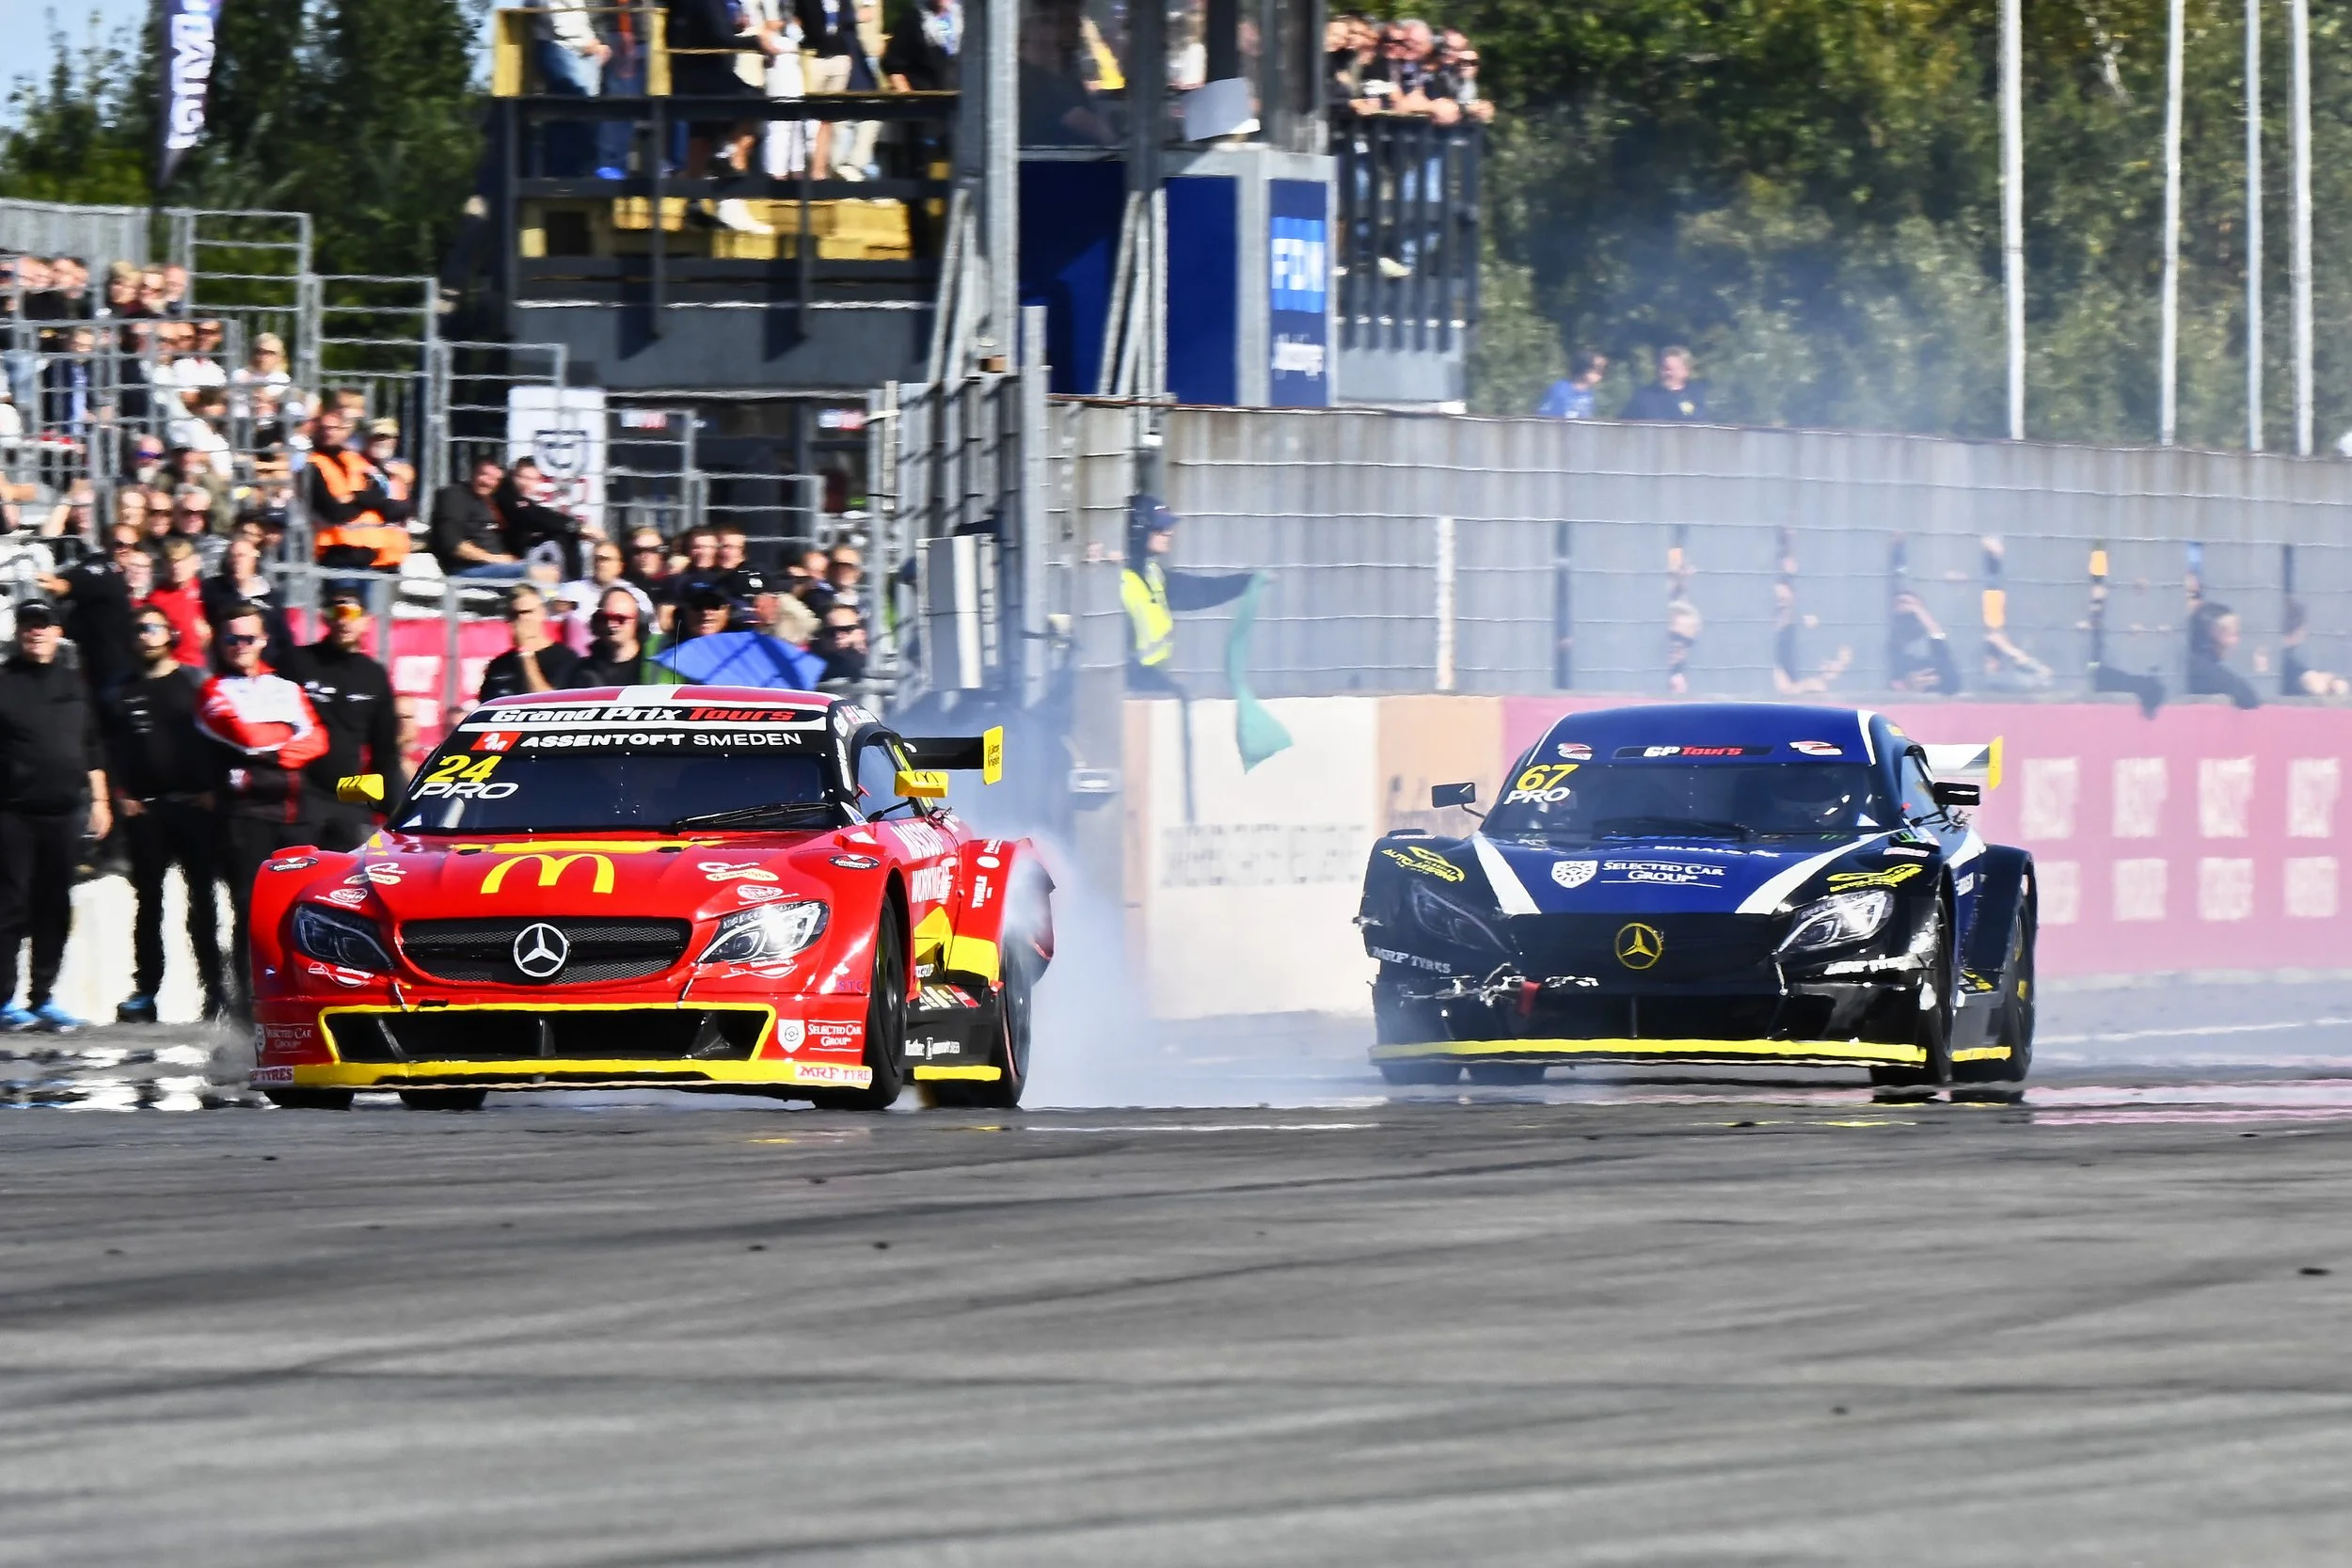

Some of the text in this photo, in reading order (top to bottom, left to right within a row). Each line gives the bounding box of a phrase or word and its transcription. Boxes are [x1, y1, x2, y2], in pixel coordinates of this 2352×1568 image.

[490, 706, 796, 722] Grand Prix Tours
[520, 734, 686, 748] ASSENTOFT
[692, 732, 803, 747] SMEDEN
[1643, 746, 1743, 757] GP Tours
[423, 754, 502, 784] 24
[1517, 764, 1580, 791] 67
[411, 782, 519, 800] PRO
[1503, 787, 1572, 804] PRO
[1601, 862, 1725, 876] SELECTED CAR
[1411, 955, 1452, 974] TYRES
[807, 1024, 863, 1036] SELECTED CAR
[262, 1068, 294, 1082] TYRES
[799, 1066, 871, 1081] MRF TYRE
